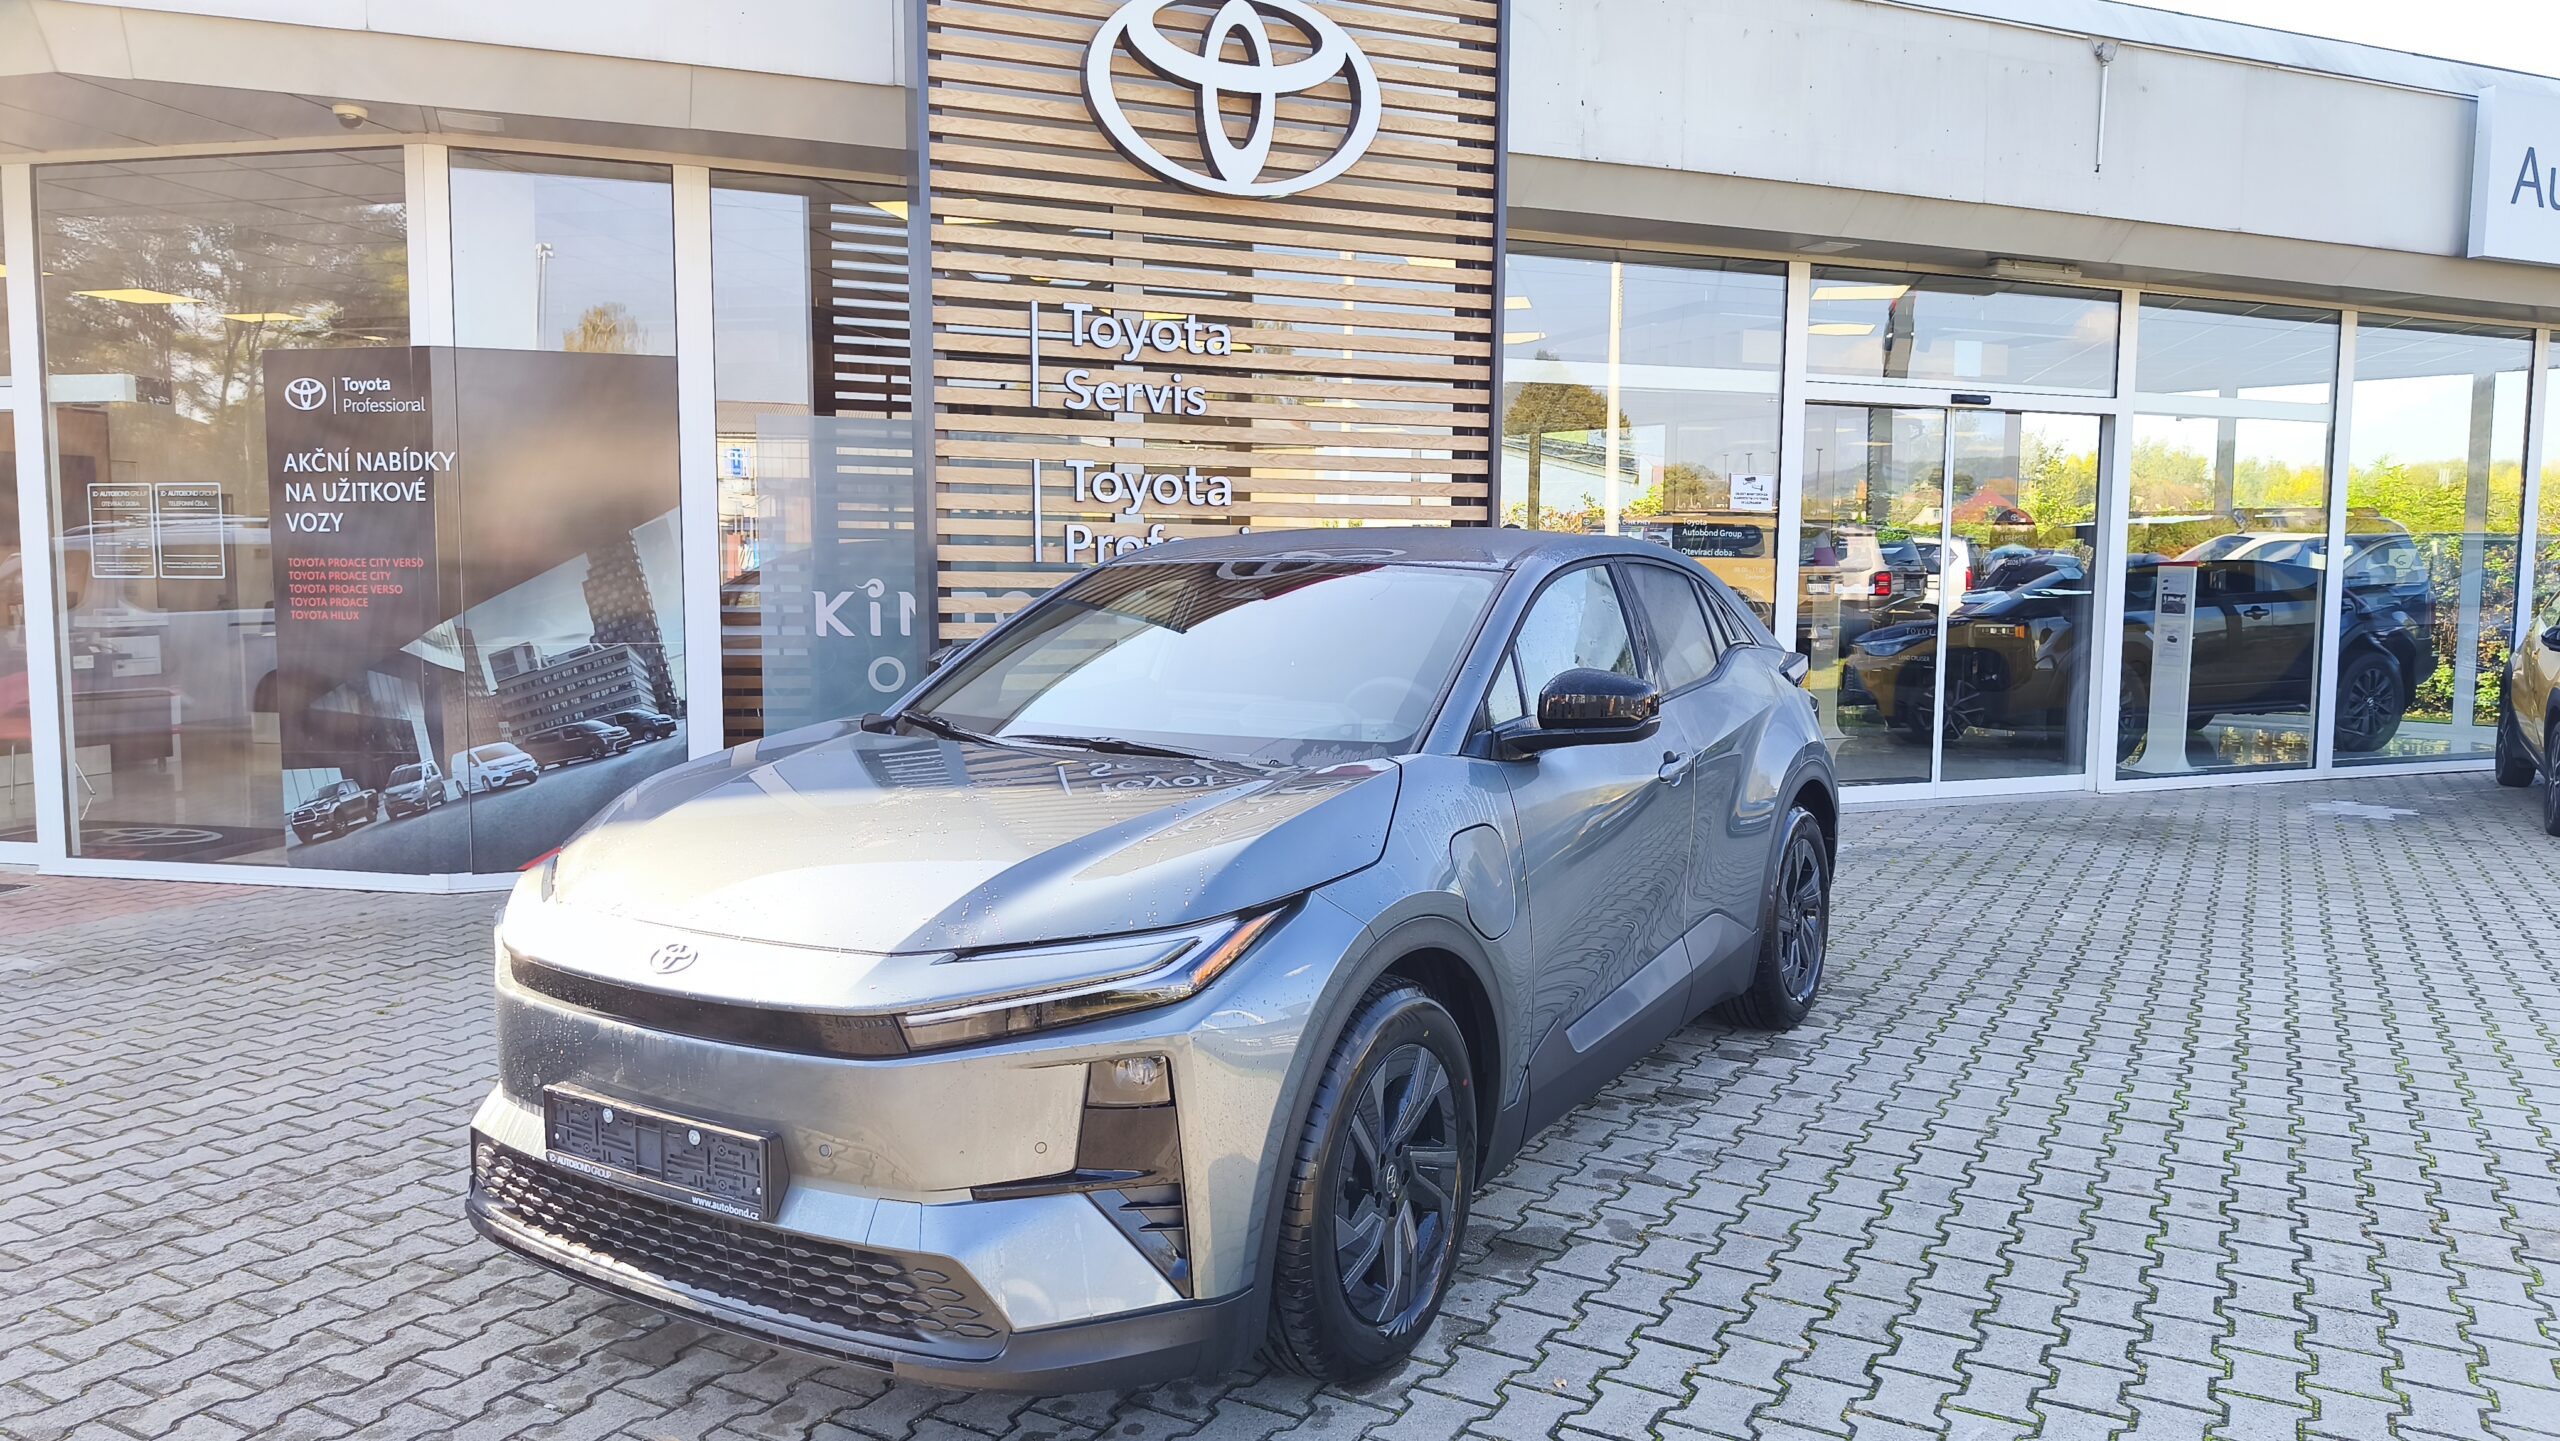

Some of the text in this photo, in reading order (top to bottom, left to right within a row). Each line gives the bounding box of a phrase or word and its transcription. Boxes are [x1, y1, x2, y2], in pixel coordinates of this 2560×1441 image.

[1063, 302, 1233, 362] Toyota
[341, 377, 391, 395] Toyota
[1064, 368, 1208, 417] Servis
[343, 396, 426, 413] Professional
[283, 446, 456, 473] AKČNÍ NABÍDKY
[285, 477, 427, 503] NA UŽITKOVÉ
[1065, 459, 1233, 515] Toyota
[285, 512, 344, 533] VOZY
[1682, 517, 1708, 526] Toyota
[1681, 528, 1719, 537] Autobond
[1681, 547, 1735, 557] Otevírací doba:
[288, 558, 424, 568] TOYOTA PROACE CITY VERSO
[288, 571, 391, 580] TOYOTA PROACE CITY
[289, 584, 403, 594] TOYOTA PROACE VERSO
[290, 597, 368, 607] TOYOTA PROACE
[290, 610, 359, 620] TOYOTA HILUX
[1906, 627, 1937, 635] TOYOT
[557, 1156, 612, 1179] AUTOBOND GROUP
[691, 1196, 760, 1221] www.autobond.cz
